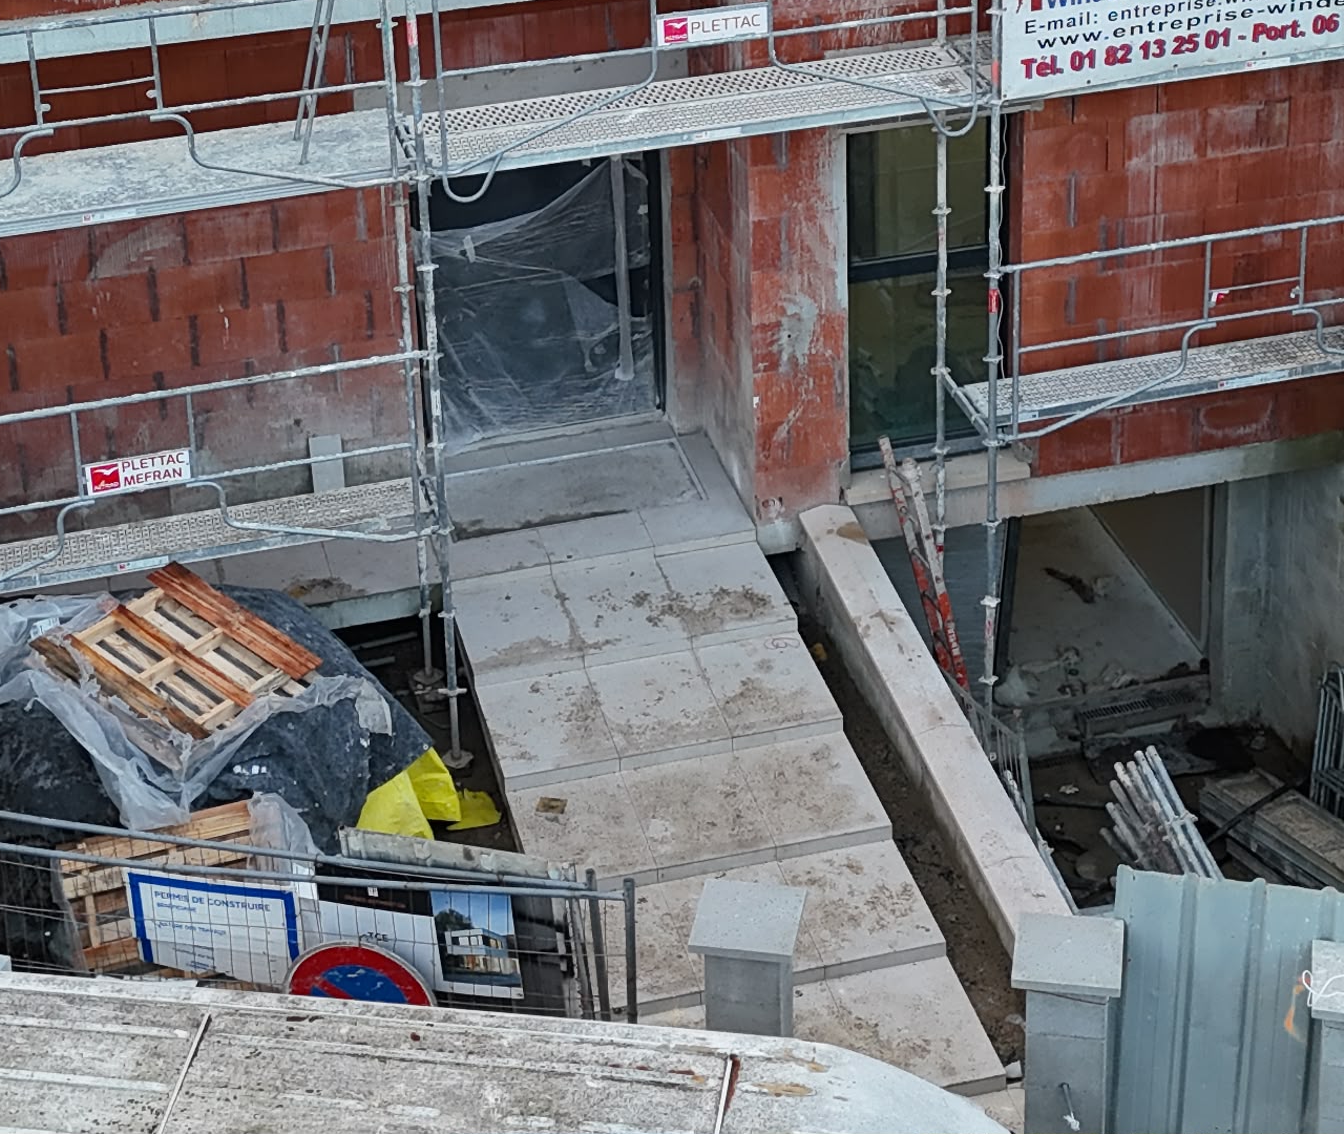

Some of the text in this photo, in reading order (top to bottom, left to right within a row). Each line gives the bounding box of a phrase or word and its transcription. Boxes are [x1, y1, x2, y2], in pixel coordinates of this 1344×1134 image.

[691, 14, 760, 34] PLETTAC
[1025, 11, 1099, 35] E-mail:
[1021, 54, 1064, 79] Tél.
[1070, 48, 1097, 72] 01
[1104, 43, 1133, 67] 82
[1139, 38, 1167, 60] 13
[1171, 32, 1201, 56] 25
[1204, 26, 1232, 50] 01
[1252, 18, 1306, 43] Port.
[1312, 13, 1340, 35] 06
[122, 452, 185, 473] PLETTAC
[124, 467, 183, 487] MEFRAN
[154, 890, 189, 903] PERMIS
[191, 896, 205, 905] DE
[207, 898, 271, 912] CONSTRUIRE
